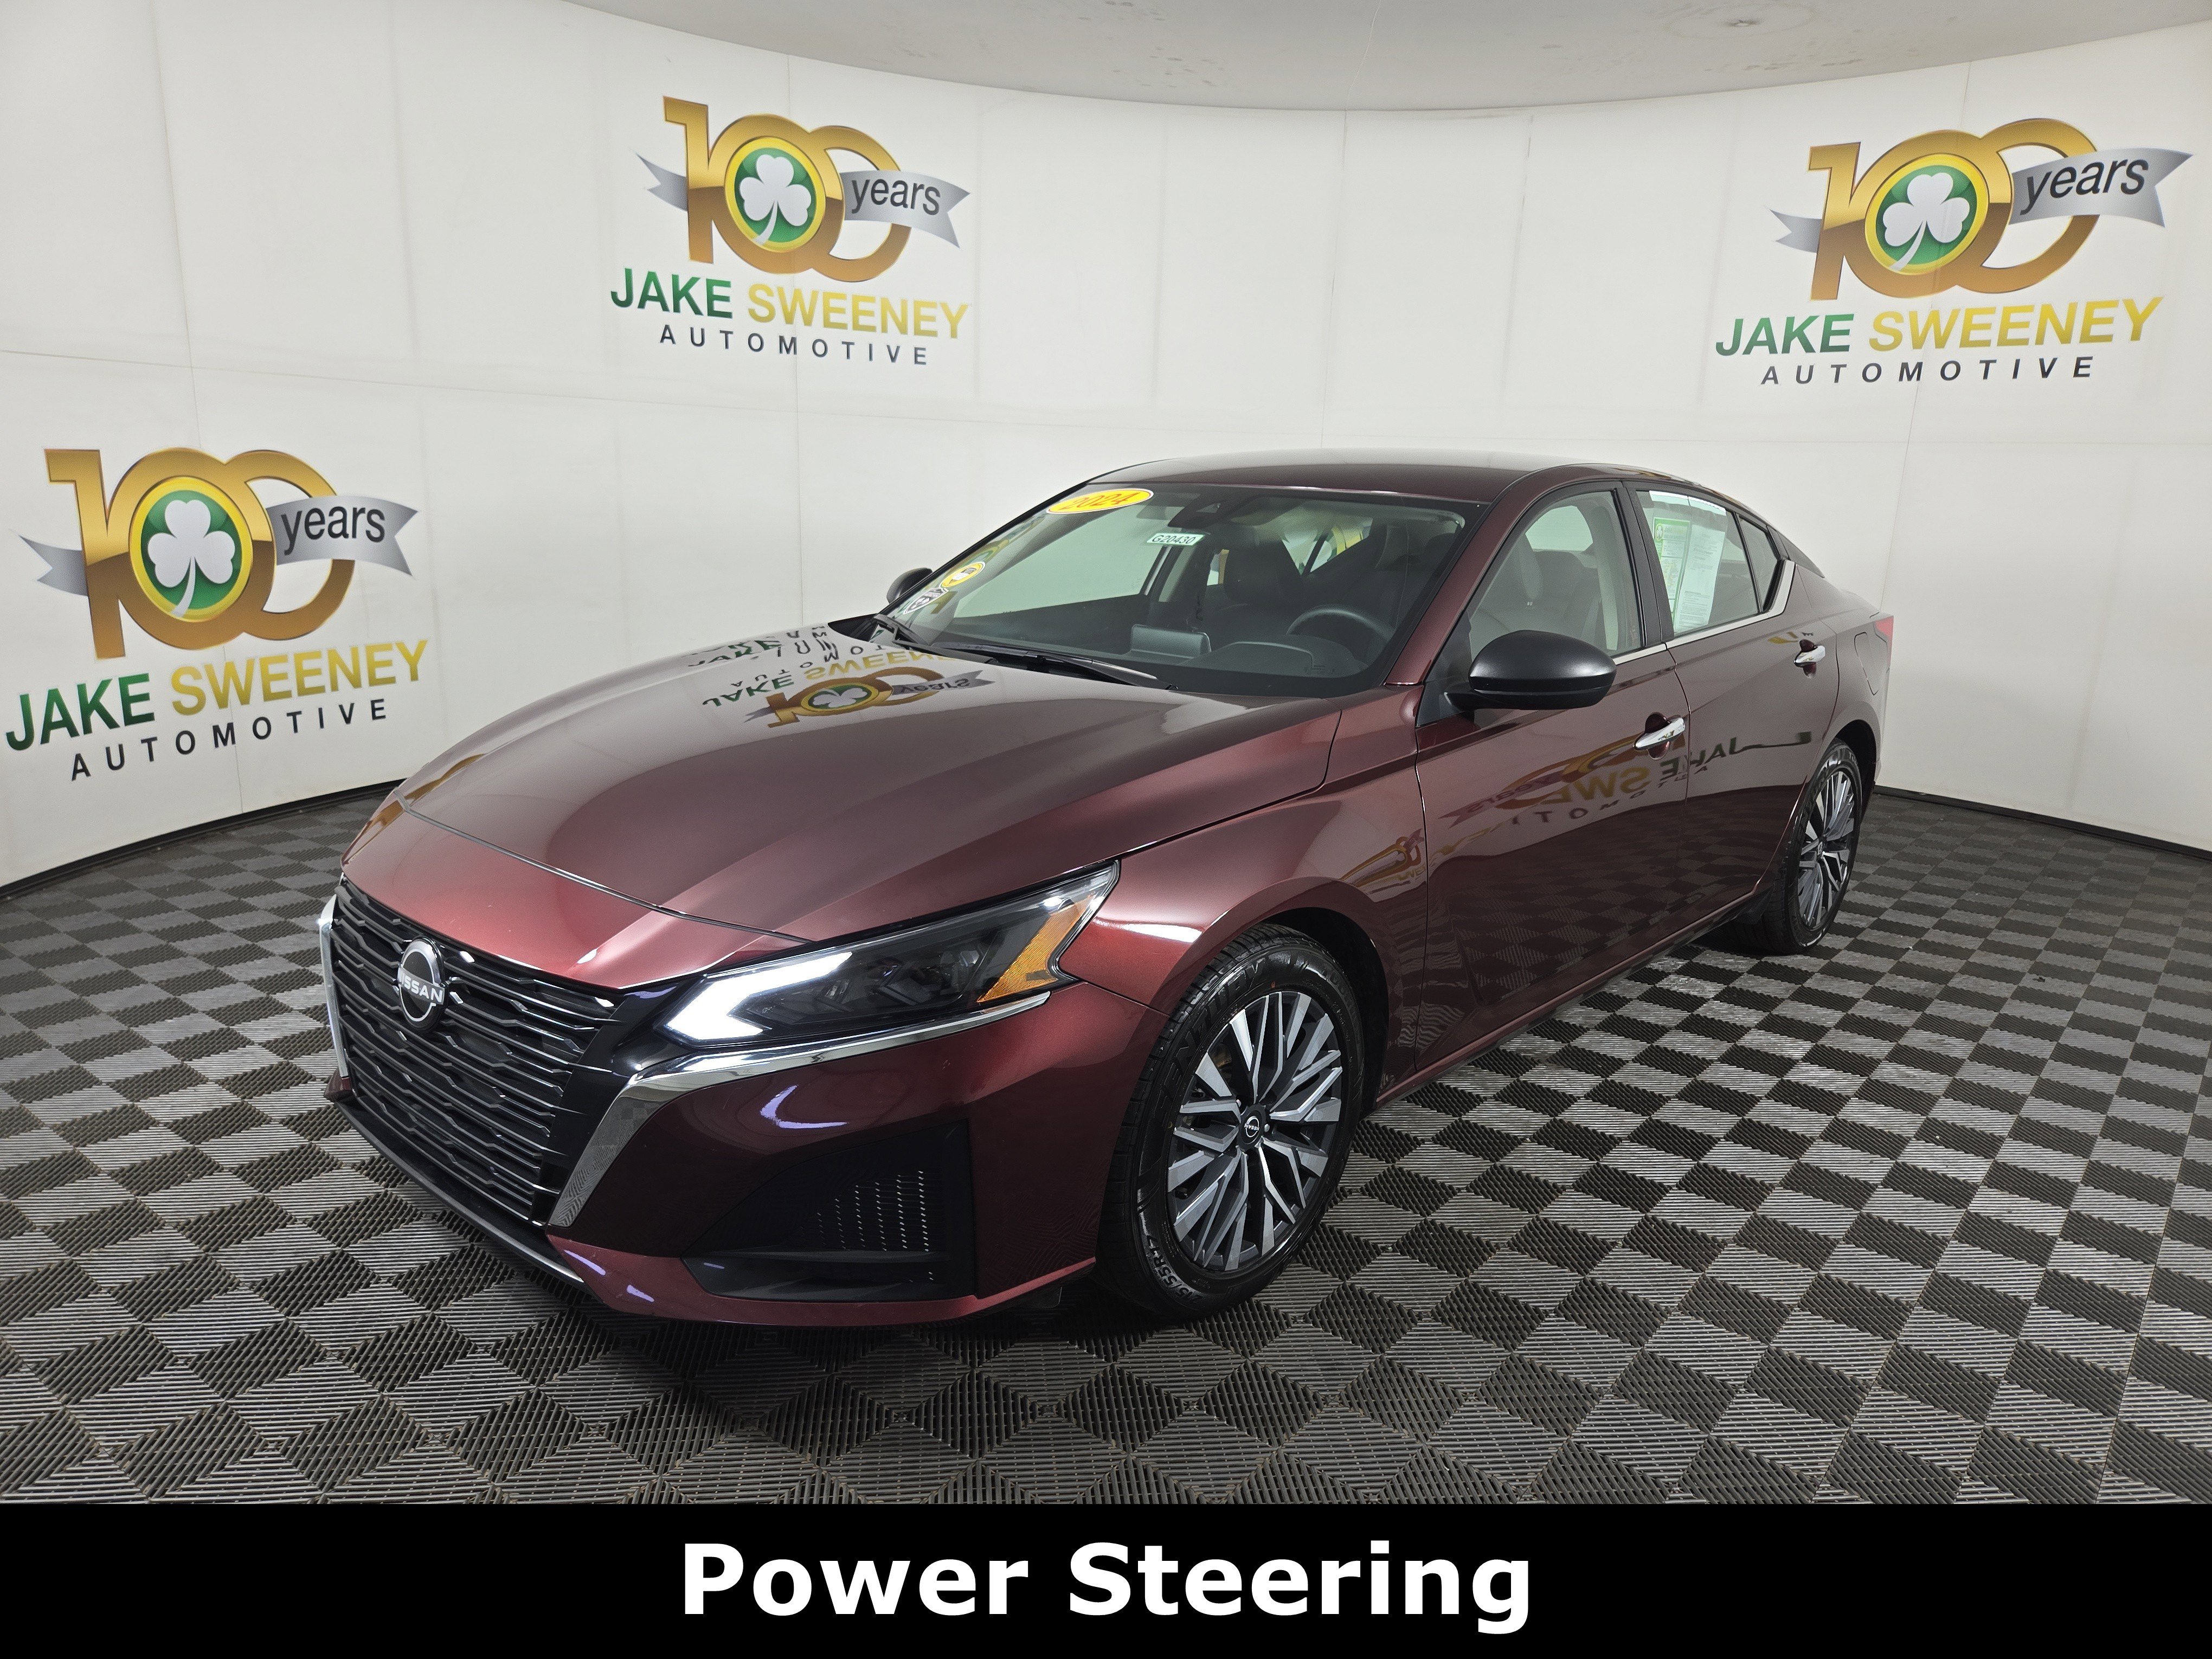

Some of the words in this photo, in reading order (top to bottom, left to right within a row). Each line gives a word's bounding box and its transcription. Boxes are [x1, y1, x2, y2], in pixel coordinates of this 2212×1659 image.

[663, 95, 912, 282] 100
[851, 179, 942, 215] years
[1808, 118, 2101, 301] 100
[2020, 158, 2149, 216] years
[610, 268, 734, 319] JAKE
[747, 284, 969, 339] SWEENEY
[1715, 313, 1855, 357] JAKE
[1869, 296, 2165, 352] SWEENEY
[659, 324, 928, 365] AUTOMOTIVE
[1761, 356, 2094, 386] AUTOMOTIVE
[280, 505, 386, 555] years
[1058, 492, 1141, 510] 2024
[44, 447, 356, 660] 100
[1151, 534, 1197, 544] G20430
[5, 673, 156, 751] JAKE
[170, 640, 429, 716] SWEENEY
[71, 699, 387, 782] AUTOMOTIVE
[398, 970, 443, 1004] NISSAN
